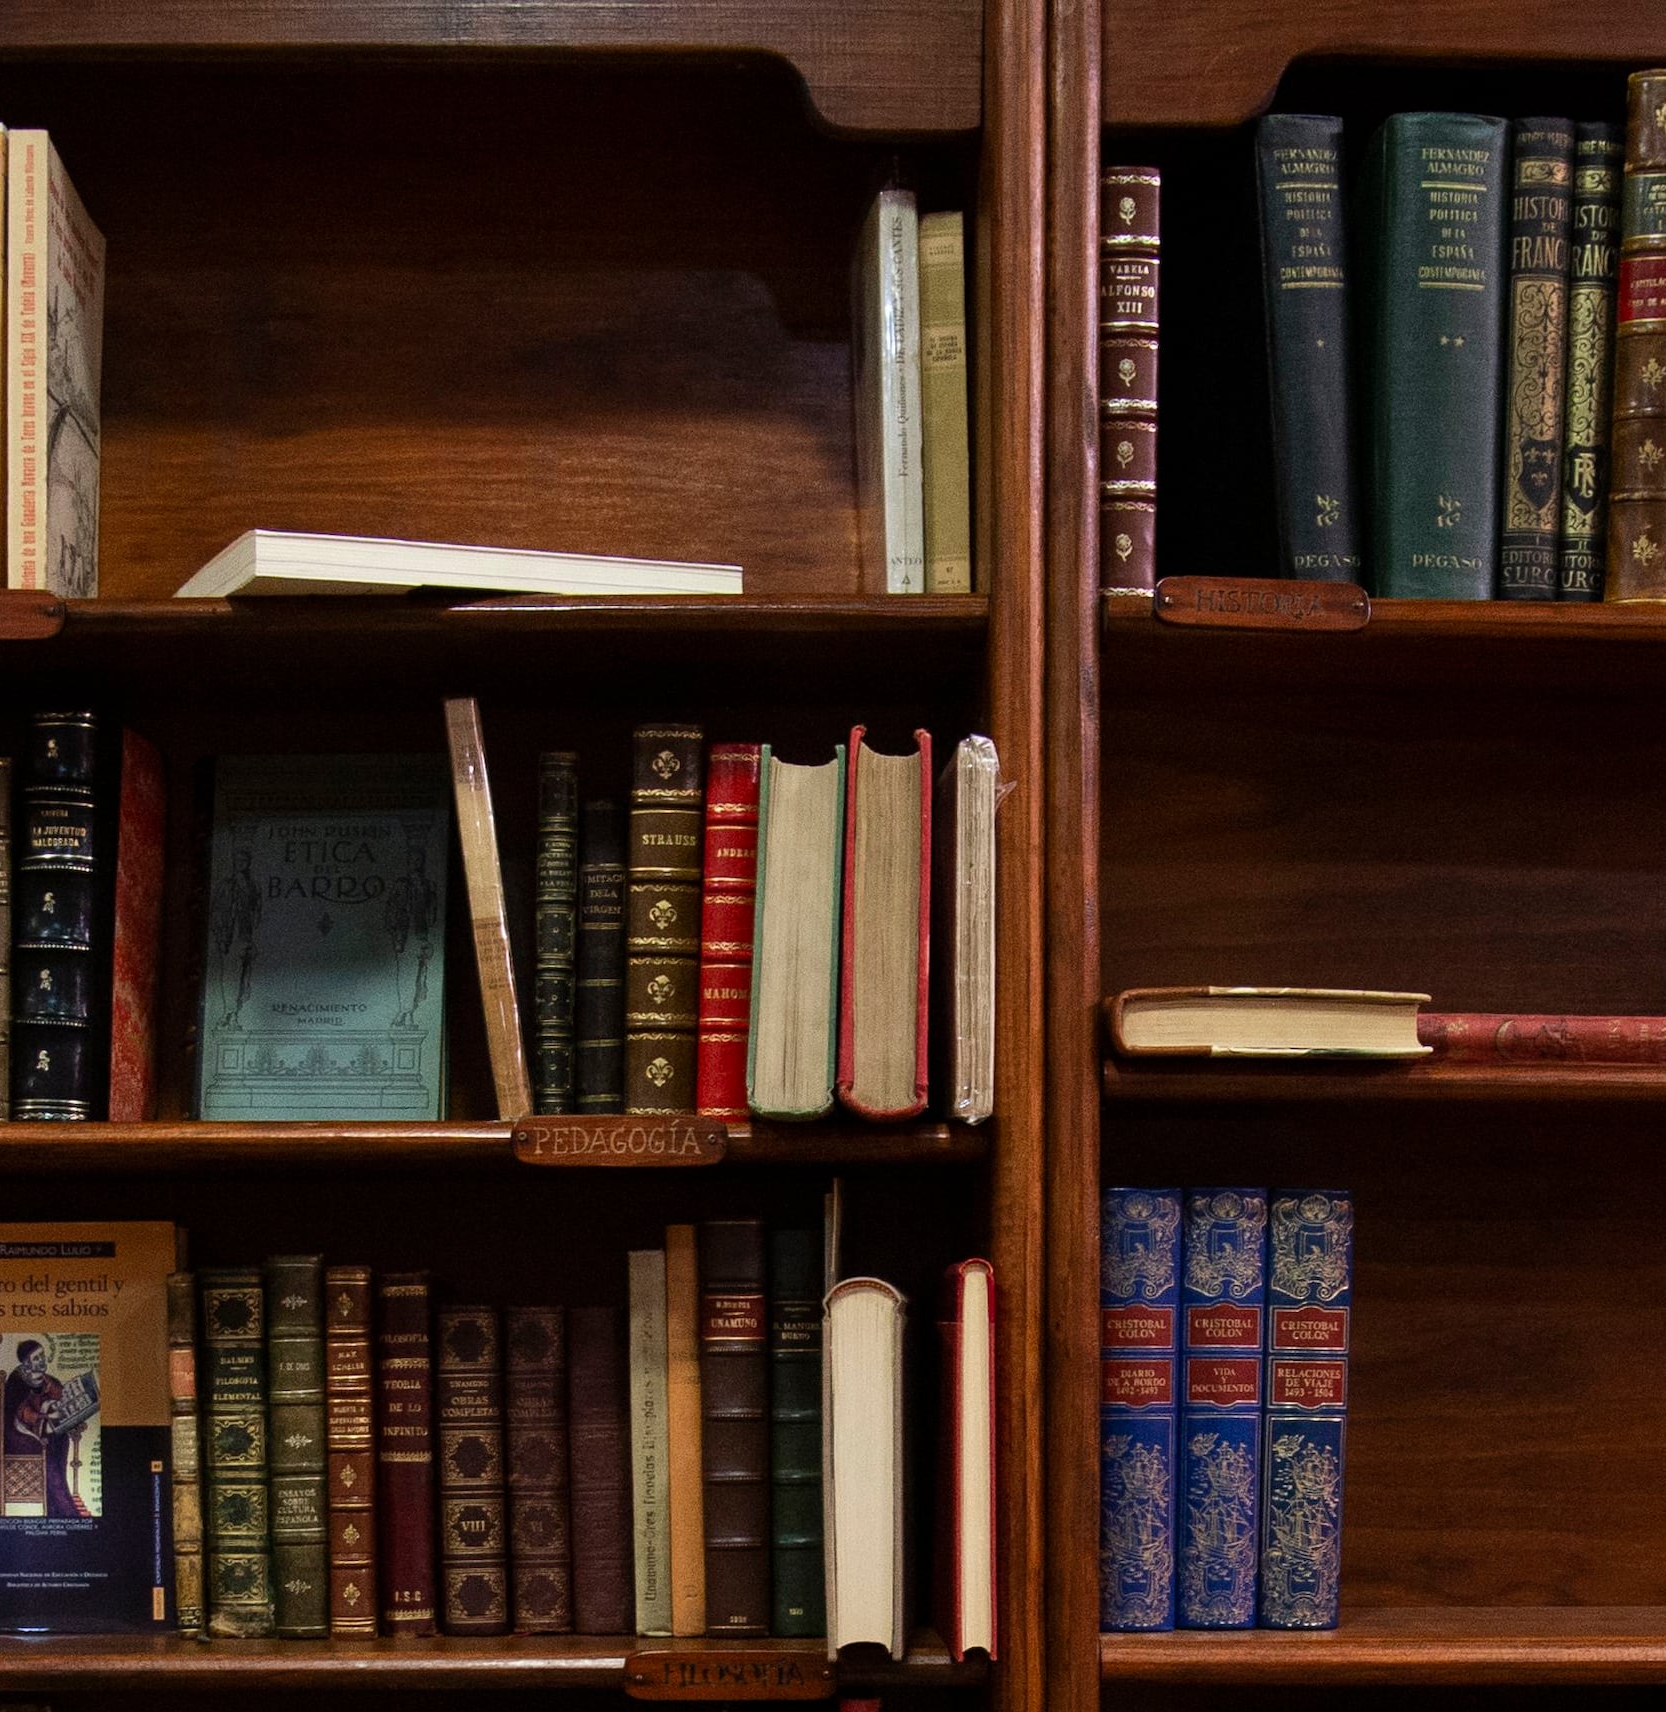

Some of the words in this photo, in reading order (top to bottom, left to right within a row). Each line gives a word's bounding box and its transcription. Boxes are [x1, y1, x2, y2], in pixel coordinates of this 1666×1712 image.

[1429, 192, 1479, 205] HISTORIA
[1432, 242, 1475, 260] ESPAÑA
[1110, 265, 1149, 275] VARELA
[1101, 285, 1155, 298] ALFONSO
[1293, 554, 1363, 570] PEGASO
[1412, 554, 1483, 571] PEGASO
[641, 833, 698, 847] STRAUSS
[283, 841, 377, 864] ETICA
[267, 875, 386, 904] BARRO
[271, 1002, 368, 1014] RENACIMIENTO
[532, 1119, 703, 1156] PEDAGOGÍA
[21, 1274, 49, 1294] del
[53, 1274, 109, 1299] gentil
[111, 1278, 125, 1299] y
[12, 1301, 47, 1318] tres
[51, 1298, 109, 1318] sabios
[710, 1317, 758, 1330] UNAMUNO
[1106, 1318, 1167, 1330] CRISTOBAL
[1194, 1318, 1254, 1330] CRISTOBAL
[1280, 1320, 1340, 1333] CRISTOBAL
[1118, 1327, 1156, 1339] COLON
[1205, 1327, 1244, 1339] COLON
[1291, 1329, 1330, 1341] COLON
[1212, 1367, 1237, 1379] VIDA
[1276, 1367, 1342, 1381] RELACIONES
[383, 1379, 422, 1390] TEORIA
[1190, 1382, 1256, 1395] DOCUMENTOS
[450, 1395, 489, 1406] OBRAS
[441, 1408, 499, 1418] COMPLETAS
[382, 1425, 429, 1437] INFINITO
